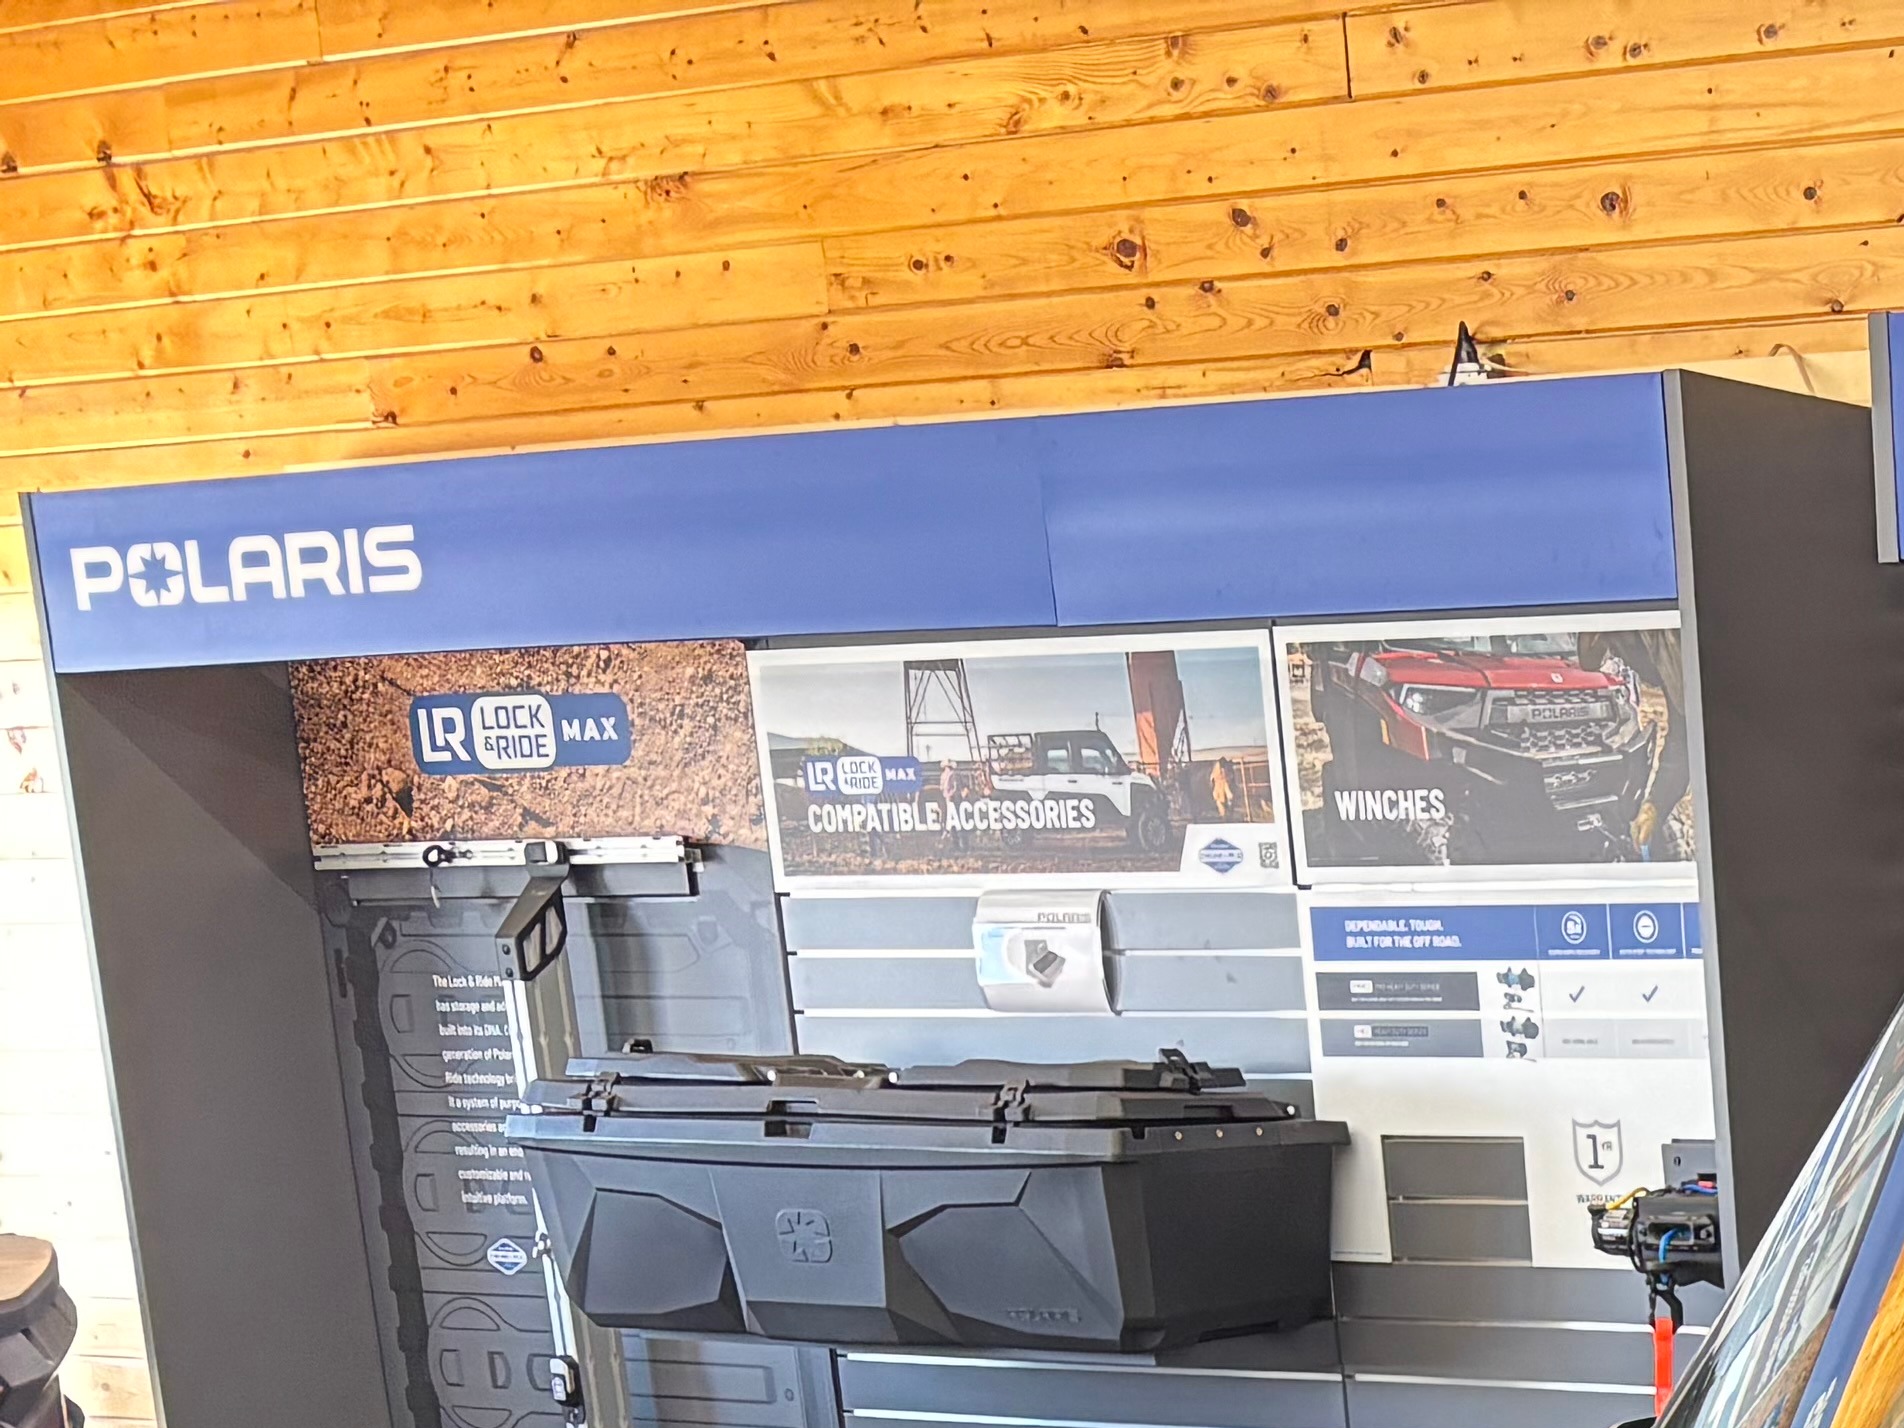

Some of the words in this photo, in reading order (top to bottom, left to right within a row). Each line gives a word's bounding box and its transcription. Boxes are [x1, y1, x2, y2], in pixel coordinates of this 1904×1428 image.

[70, 525, 422, 611] POLARIS
[480, 704, 545, 730] LOCK
[561, 717, 618, 742] MAX
[841, 762, 877, 775] LOCK
[884, 766, 916, 783] MAX
[807, 802, 942, 833] COMPATIBLE
[944, 798, 1096, 831] ACCESSORIES
[1334, 788, 1446, 821] WINCHES
[1586, 1133, 1604, 1169] 1
